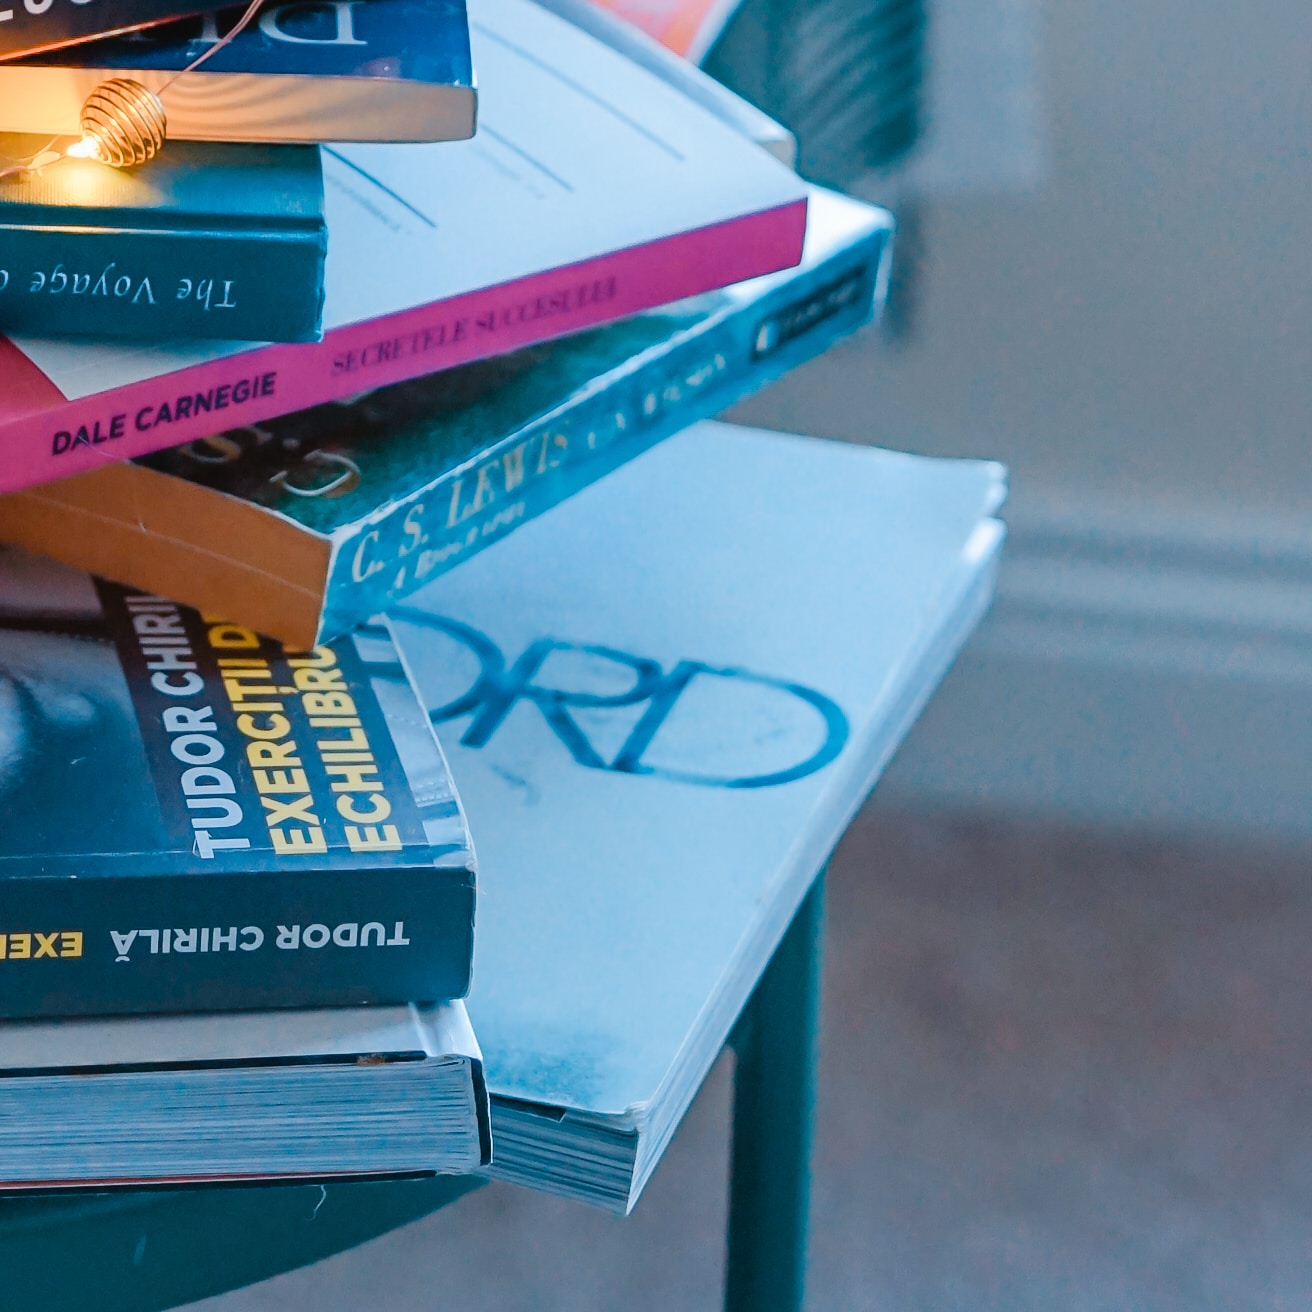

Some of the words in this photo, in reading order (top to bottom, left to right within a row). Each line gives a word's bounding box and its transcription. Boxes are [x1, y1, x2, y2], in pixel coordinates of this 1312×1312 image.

[29, 263, 156, 304] Voyage
[176, 278, 237, 310] The
[331, 318, 470, 375] SECRETELE
[51, 415, 127, 456] DALE
[135, 372, 277, 432] CARNEGIE
[352, 531, 385, 583] C.
[398, 504, 428, 558] S.
[446, 431, 568, 529] LEWIS
[203, 613, 260, 649] D
[217, 658, 328, 855] EXERCIȚII
[162, 705, 250, 859] TUDOR
[109, 925, 264, 963] CHIRILĂ
[275, 921, 410, 950] TUDOR
